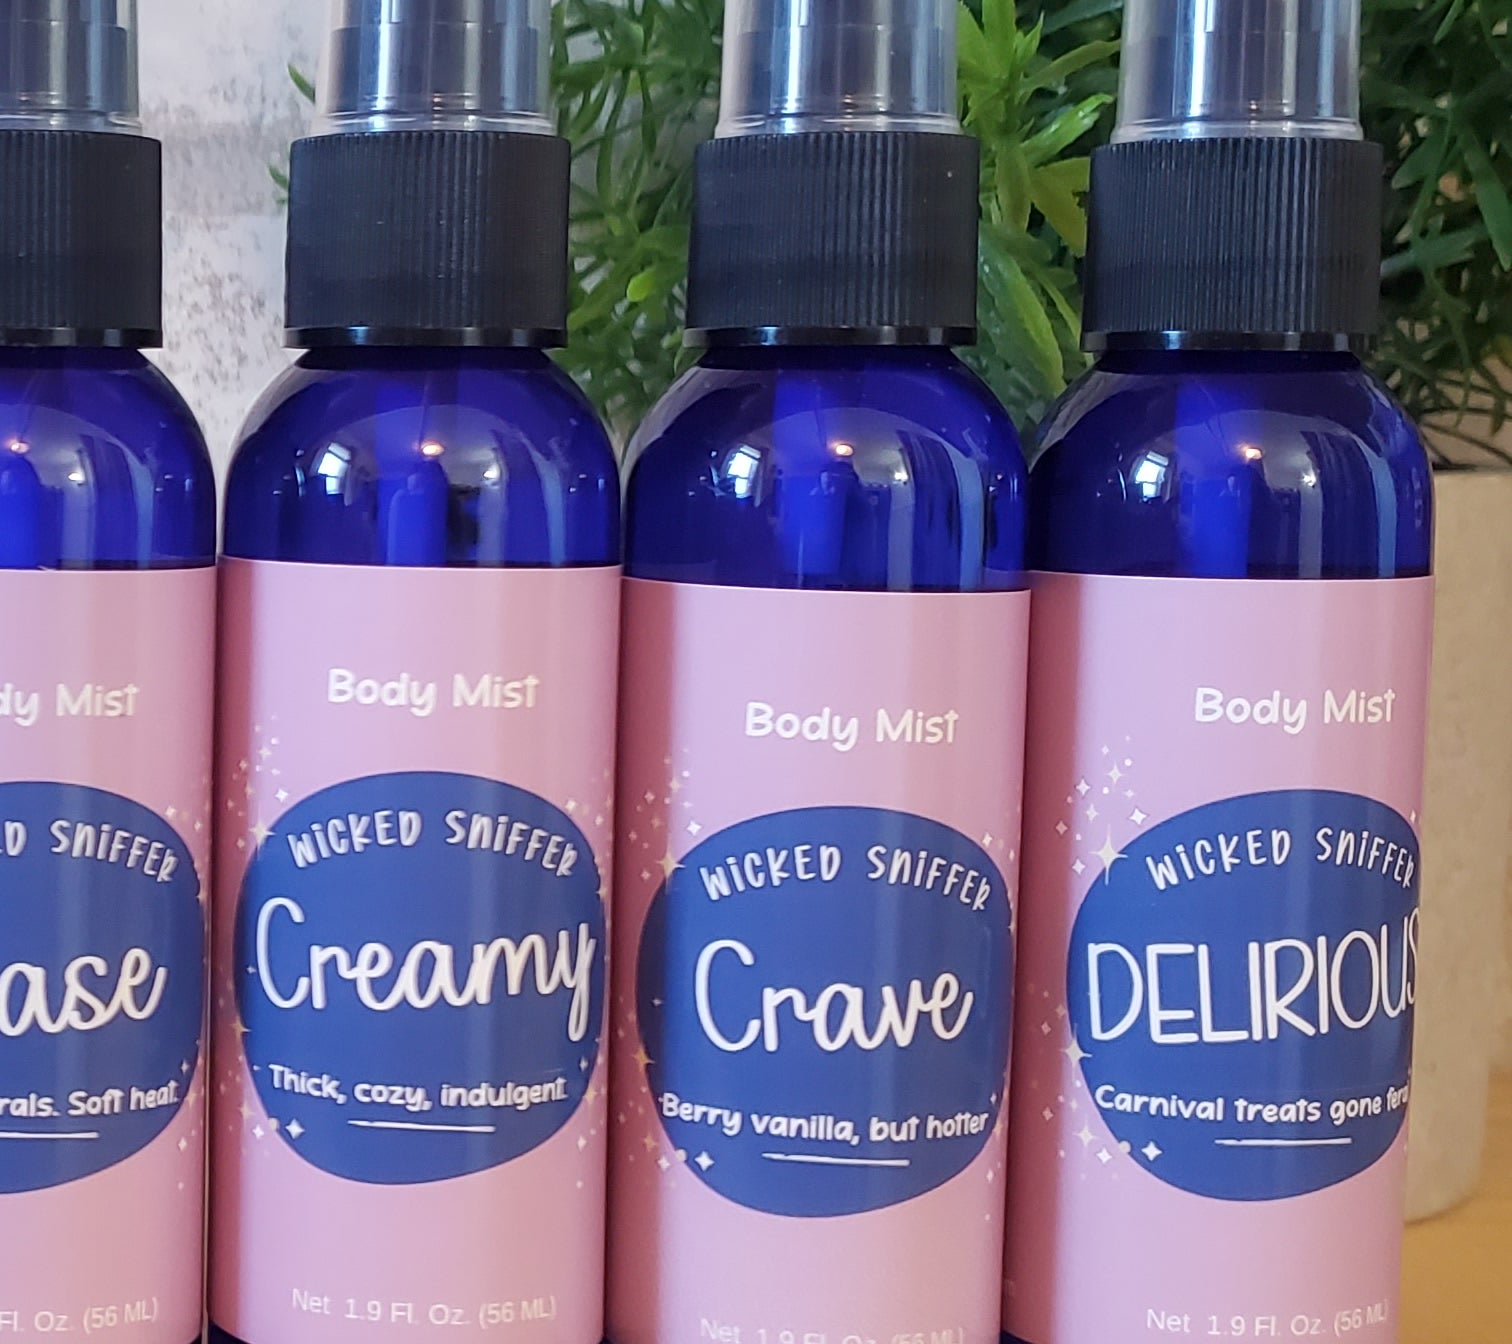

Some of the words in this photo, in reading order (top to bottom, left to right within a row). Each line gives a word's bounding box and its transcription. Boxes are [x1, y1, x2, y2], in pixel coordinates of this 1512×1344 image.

[57, 684, 140, 716] Mist
[328, 669, 436, 716] Body
[453, 674, 539, 707] Mist
[1195, 688, 1306, 734] Body
[1324, 689, 1395, 723] Mist
[746, 702, 858, 751] Body
[877, 709, 958, 743] Mist
[257, 898, 593, 1041] Creamy
[1088, 908, 1419, 1043] DELIRIOUS
[696, 940, 973, 1051] Crave
[68, 1089, 123, 1115] Soft
[269, 1064, 346, 1103] Thick,
[355, 1084, 431, 1111] cozy,
[1094, 1085, 1223, 1124] Carnival
[1234, 1099, 1320, 1122] treats
[1330, 1097, 1381, 1125] gone
[664, 1093, 741, 1136] Berry
[751, 1114, 859, 1145] vanilla,
[870, 1117, 919, 1141] but
[927, 1113, 989, 1140] hotter
[83, 1306, 117, 1334] (56
[125, 1297, 158, 1323] ML)
[293, 1288, 330, 1314] Net
[345, 1299, 381, 1320] 1.9
[479, 1302, 514, 1329] (56
[521, 1296, 556, 1320] ML)
[701, 1318, 740, 1344] Net
[1147, 1309, 1190, 1333] Net
[1208, 1315, 1245, 1336] 1.9
[1334, 1309, 1362, 1336] (56
